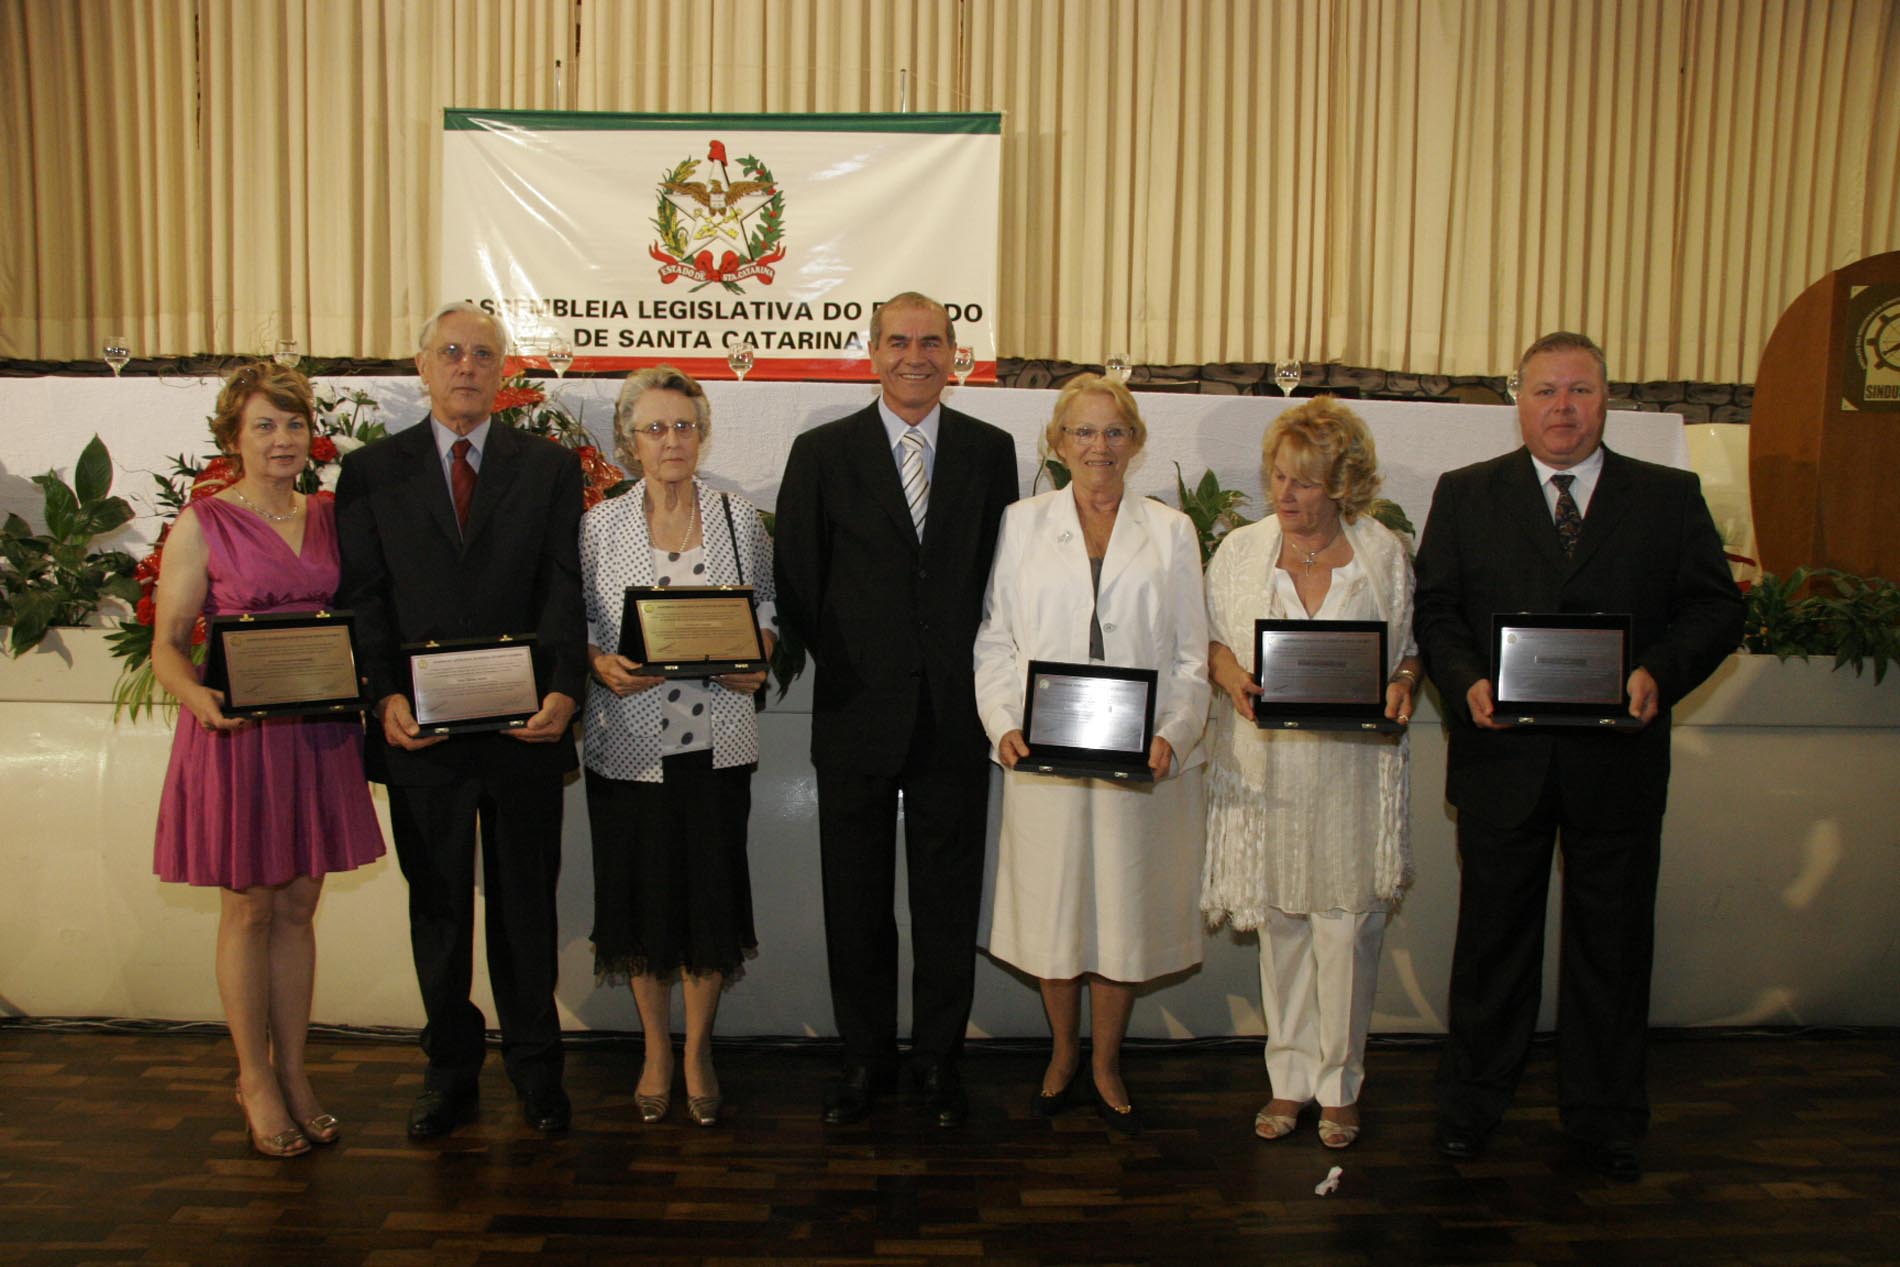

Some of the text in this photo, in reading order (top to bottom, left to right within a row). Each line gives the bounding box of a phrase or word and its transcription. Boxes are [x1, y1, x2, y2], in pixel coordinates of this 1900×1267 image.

[661, 265, 694, 278] ESTADO
[695, 271, 706, 281] DE
[465, 299, 629, 319] SEMBLEIA
[638, 300, 813, 320] LEGISLATIVA
[823, 302, 862, 321] DO
[574, 328, 863, 350] DE SANTA CATARINA
[1866, 384, 1900, 399] SINDU
